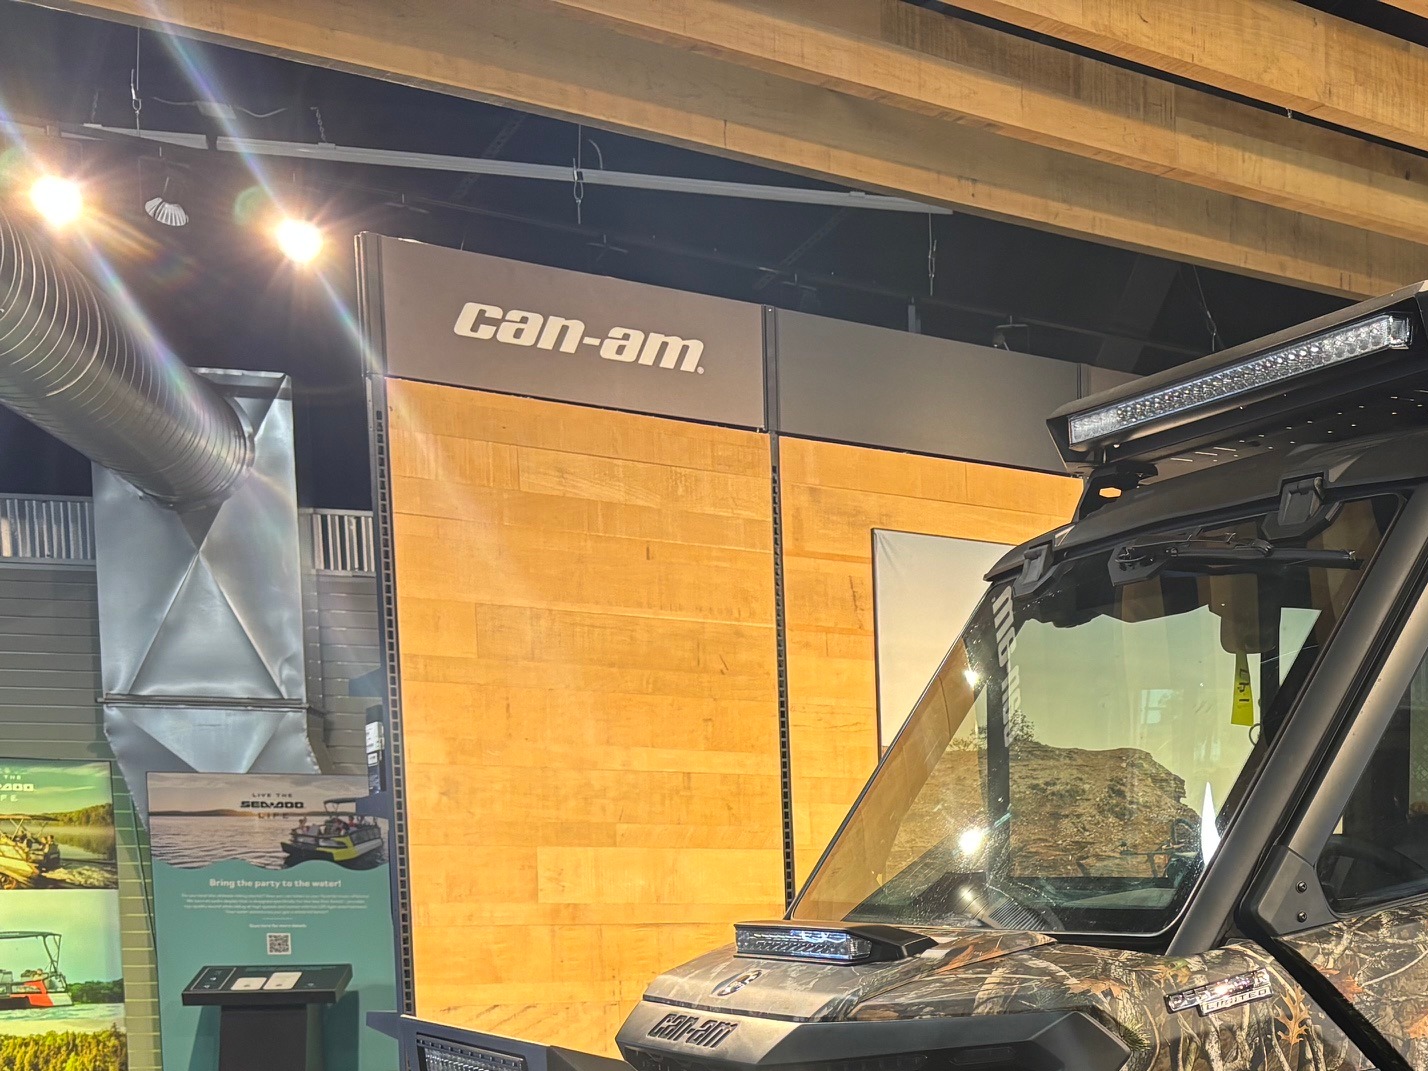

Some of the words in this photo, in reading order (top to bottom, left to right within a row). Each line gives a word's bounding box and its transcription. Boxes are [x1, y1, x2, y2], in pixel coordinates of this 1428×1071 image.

[454, 302, 704, 373] can-am
[209, 878, 235, 889] Bring
[237, 879, 253, 888] the
[254, 880, 280, 889] party
[282, 880, 293, 888] to
[295, 880, 310, 888] the
[312, 880, 342, 888] water!
[647, 1013, 739, 1048] can-am
